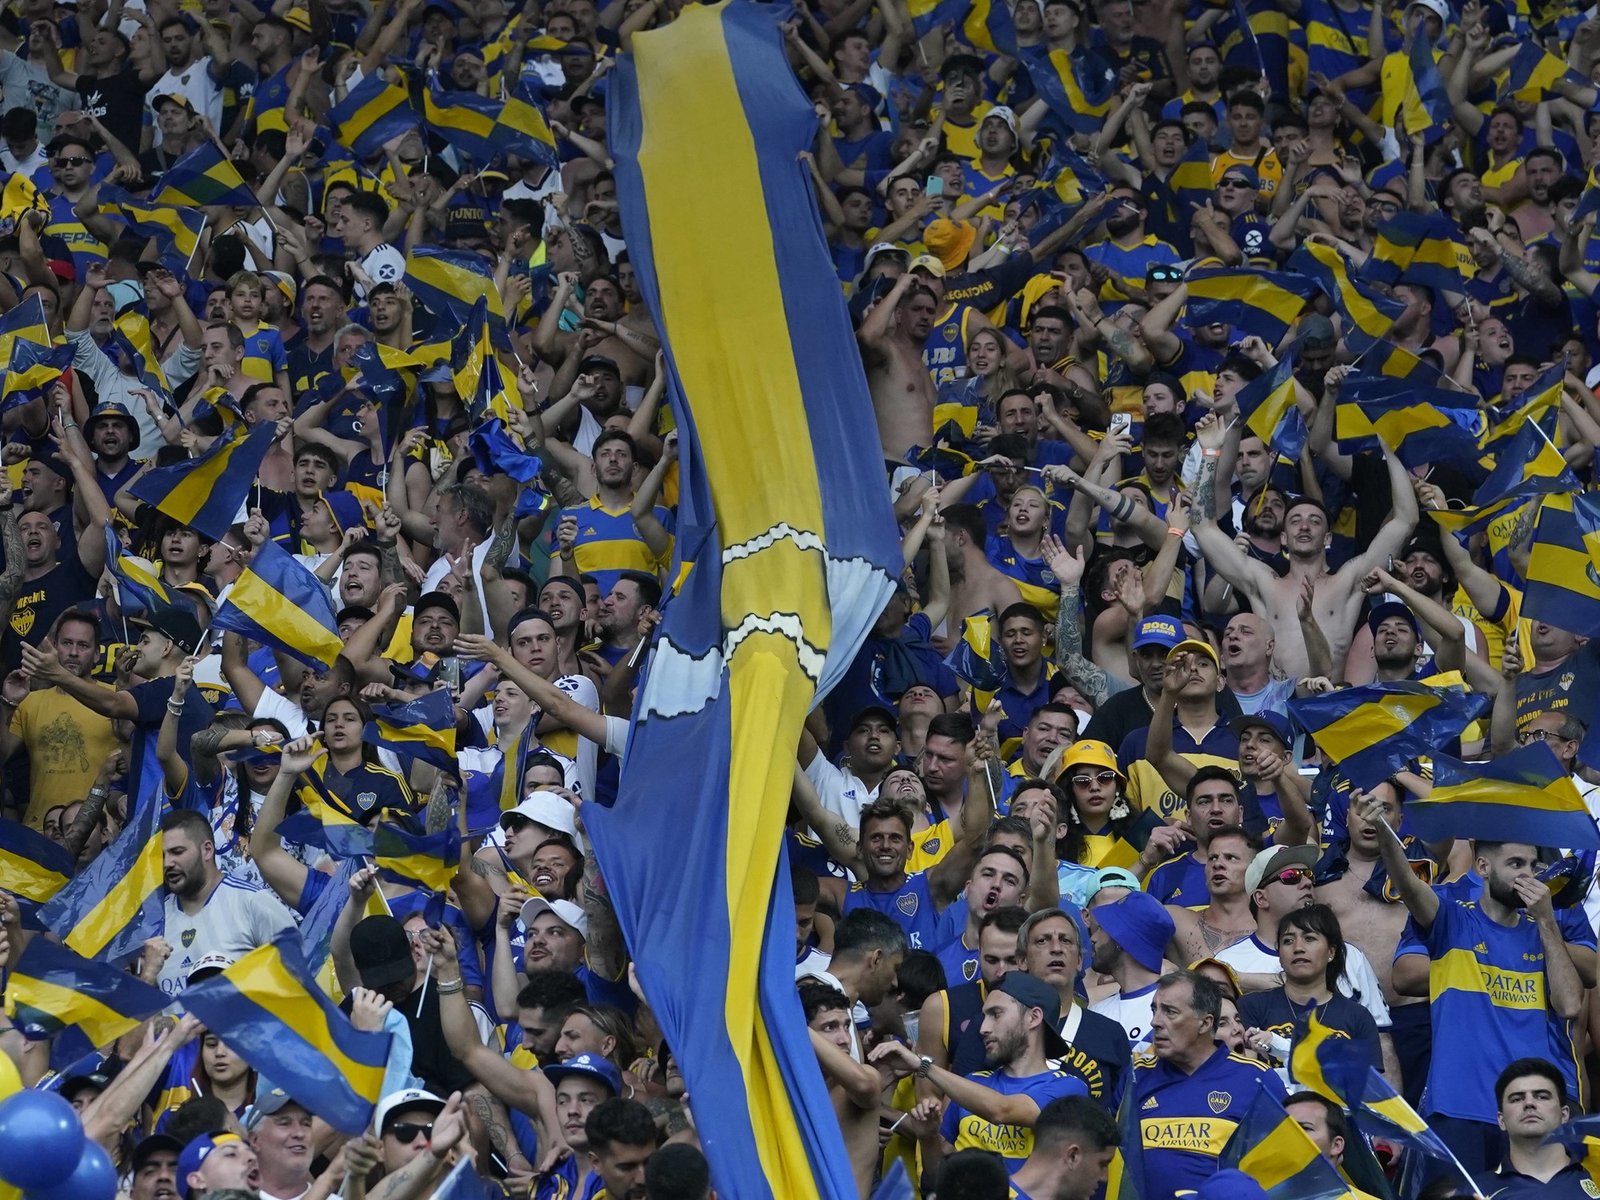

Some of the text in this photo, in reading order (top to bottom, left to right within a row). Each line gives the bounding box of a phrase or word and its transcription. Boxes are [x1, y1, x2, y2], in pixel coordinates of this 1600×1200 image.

[1143, 621, 1175, 632] BOCA
[162, 975, 187, 993] QAT
[1480, 972, 1537, 994] QATAR
[1491, 991, 1537, 1003] AIRWAYS
[1210, 1097, 1228, 1105] CABJ
[968, 1120, 1026, 1139] QATAR
[1144, 1122, 1211, 1143] QATAR
[1157, 1138, 1211, 1149] AIRWAYS
